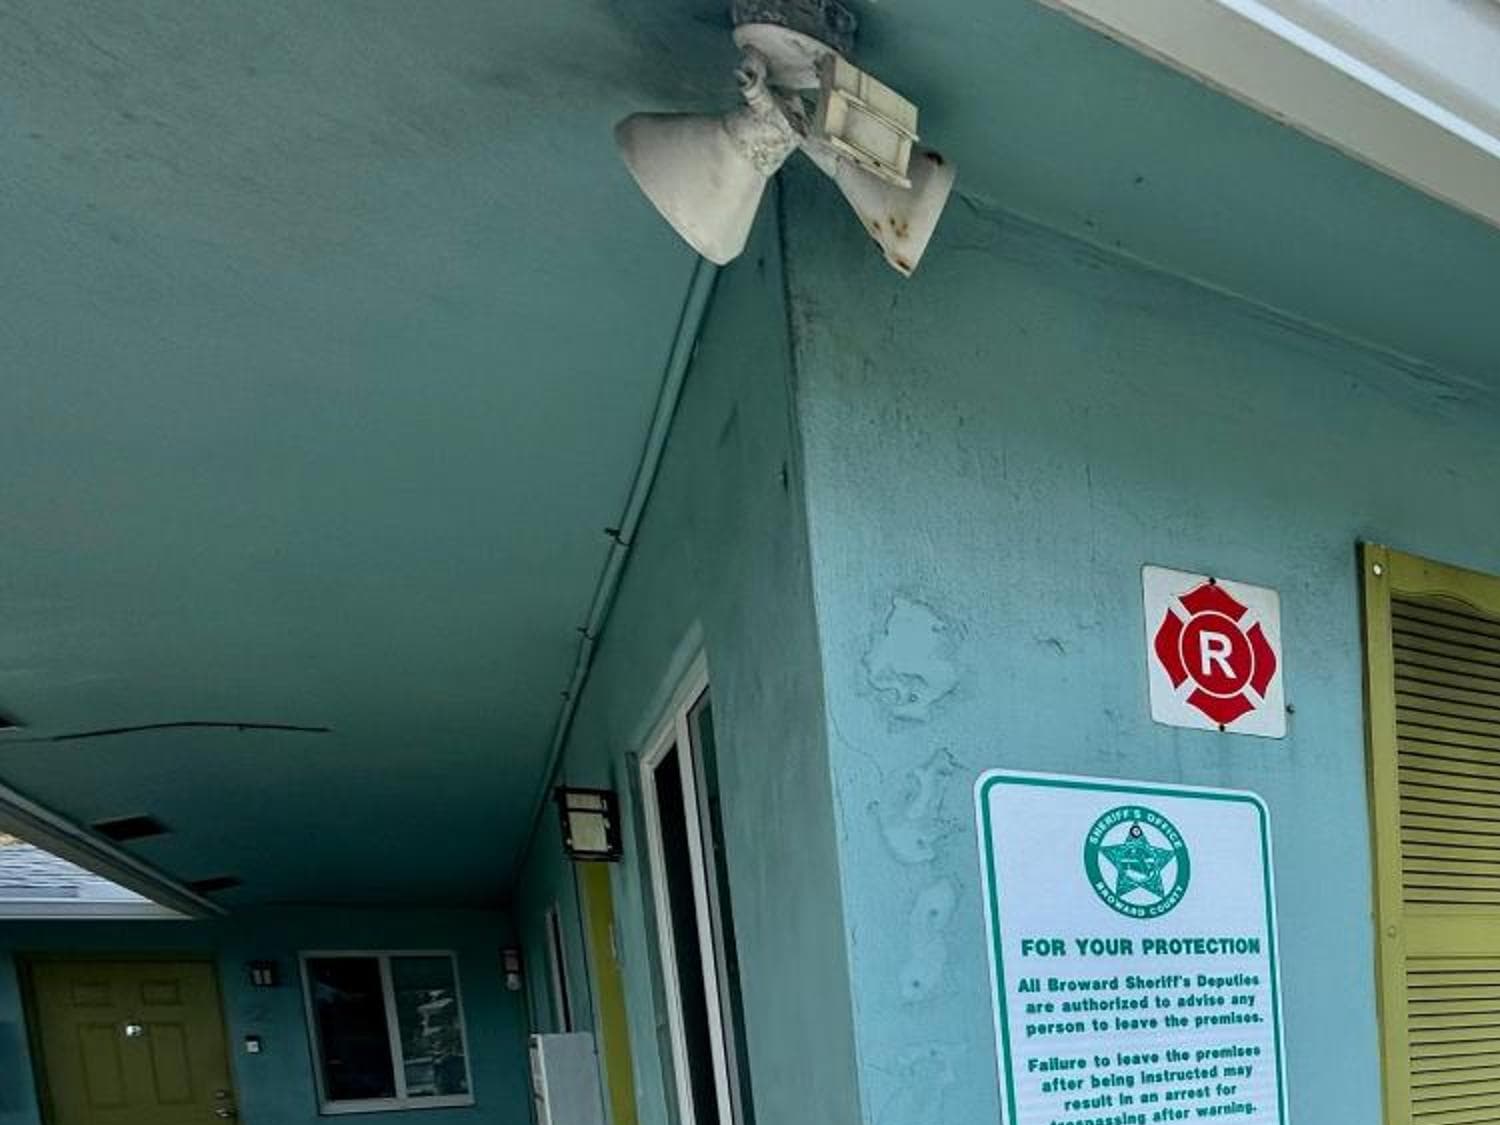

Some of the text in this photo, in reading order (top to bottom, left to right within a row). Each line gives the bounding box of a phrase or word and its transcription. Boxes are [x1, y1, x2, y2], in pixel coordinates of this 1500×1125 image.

[1199, 629, 1237, 679] R
[1147, 814, 1182, 849] OFFICE
[1096, 882, 1183, 916] BROWARD COUNTY
[1022, 938, 1261, 956] FOR YOUR PROTECTION
[1018, 973, 1260, 992] All Broward Sheriff's Deputies
[1026, 993, 1255, 1014] are authorized to advise any
[1026, 1012, 1264, 1038] person to leave the premises.
[1028, 1045, 1261, 1072] Failure to leave the premises
[1041, 1065, 1253, 1093] after being instructed may
[1064, 1084, 1237, 1111] result in an arrest for
[1152, 1107, 1190, 1122] after
[1195, 1101, 1257, 1117] warning.
